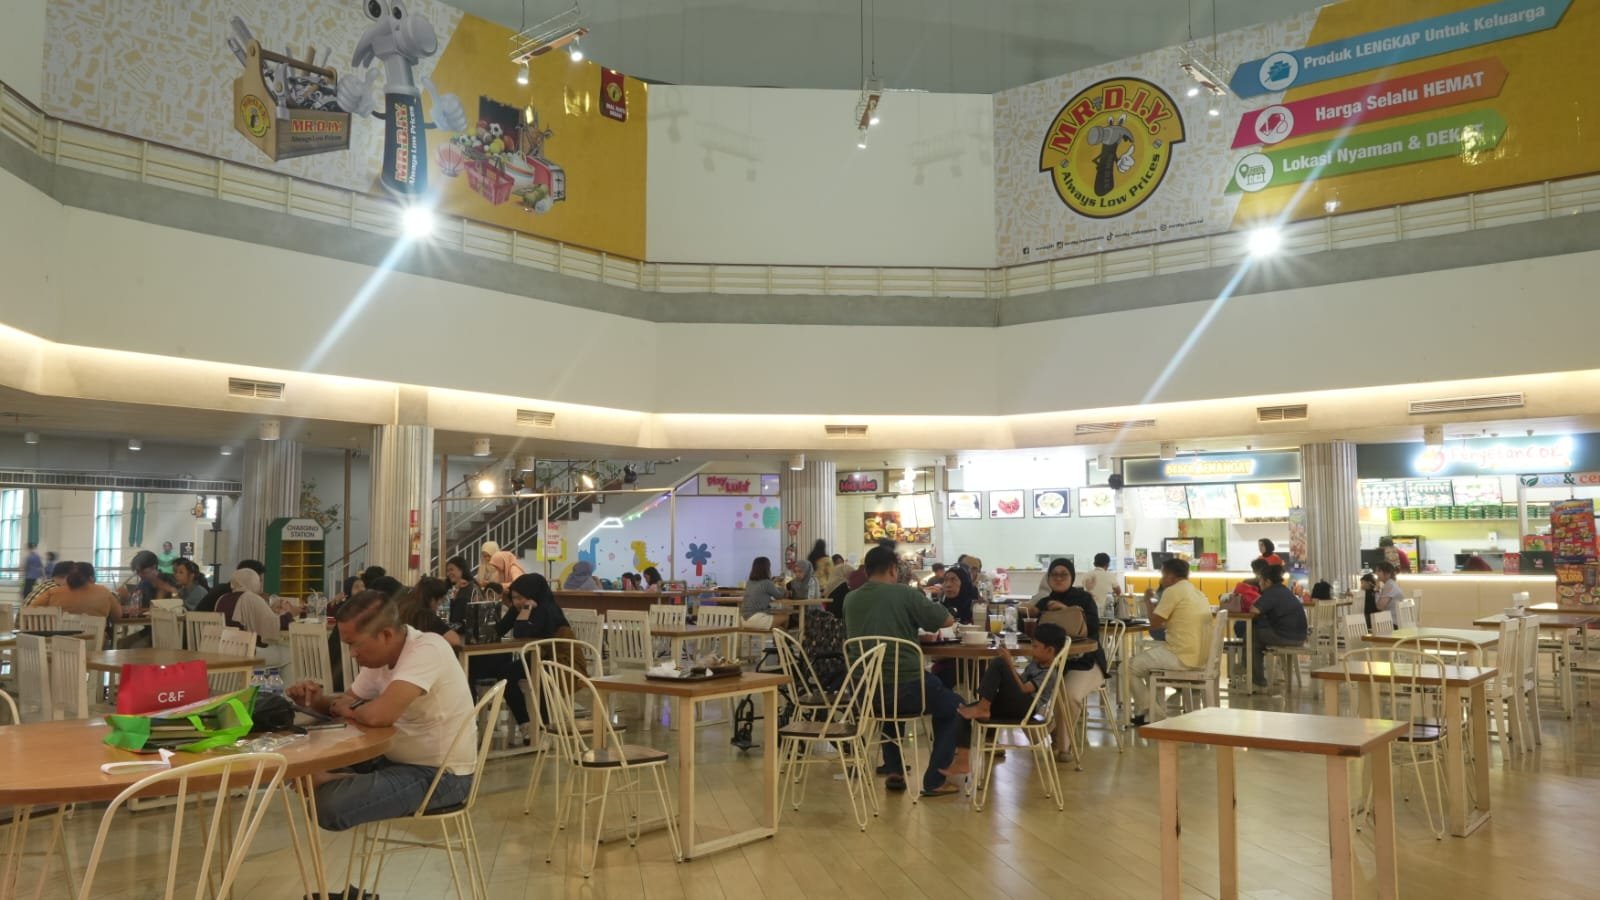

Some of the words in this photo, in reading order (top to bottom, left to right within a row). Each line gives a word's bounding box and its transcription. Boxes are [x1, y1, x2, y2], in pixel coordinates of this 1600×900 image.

[1303, 47, 1352, 69] Produk
[1356, 31, 1420, 57] LENGKAP
[1425, 22, 1469, 42] Untuk
[1474, 5, 1545, 31] Keluarga
[1315, 102, 1362, 121] Harga
[1367, 88, 1418, 110] Selalu
[1423, 71, 1484, 97] HEMAT
[1282, 152, 1332, 172] Lokasi
[1337, 141, 1403, 164] Nyaman
[1408, 135, 1421, 150] &
[1426, 123, 1484, 147] DEKT
[1062, 171, 1096, 207] Always
[1100, 194, 1127, 208] Low
[1129, 153, 1160, 197] Prices
[1562, 472, 1576, 485] &
[1579, 473, 1600, 485] ce
[157, 690, 185, 703] C&F
